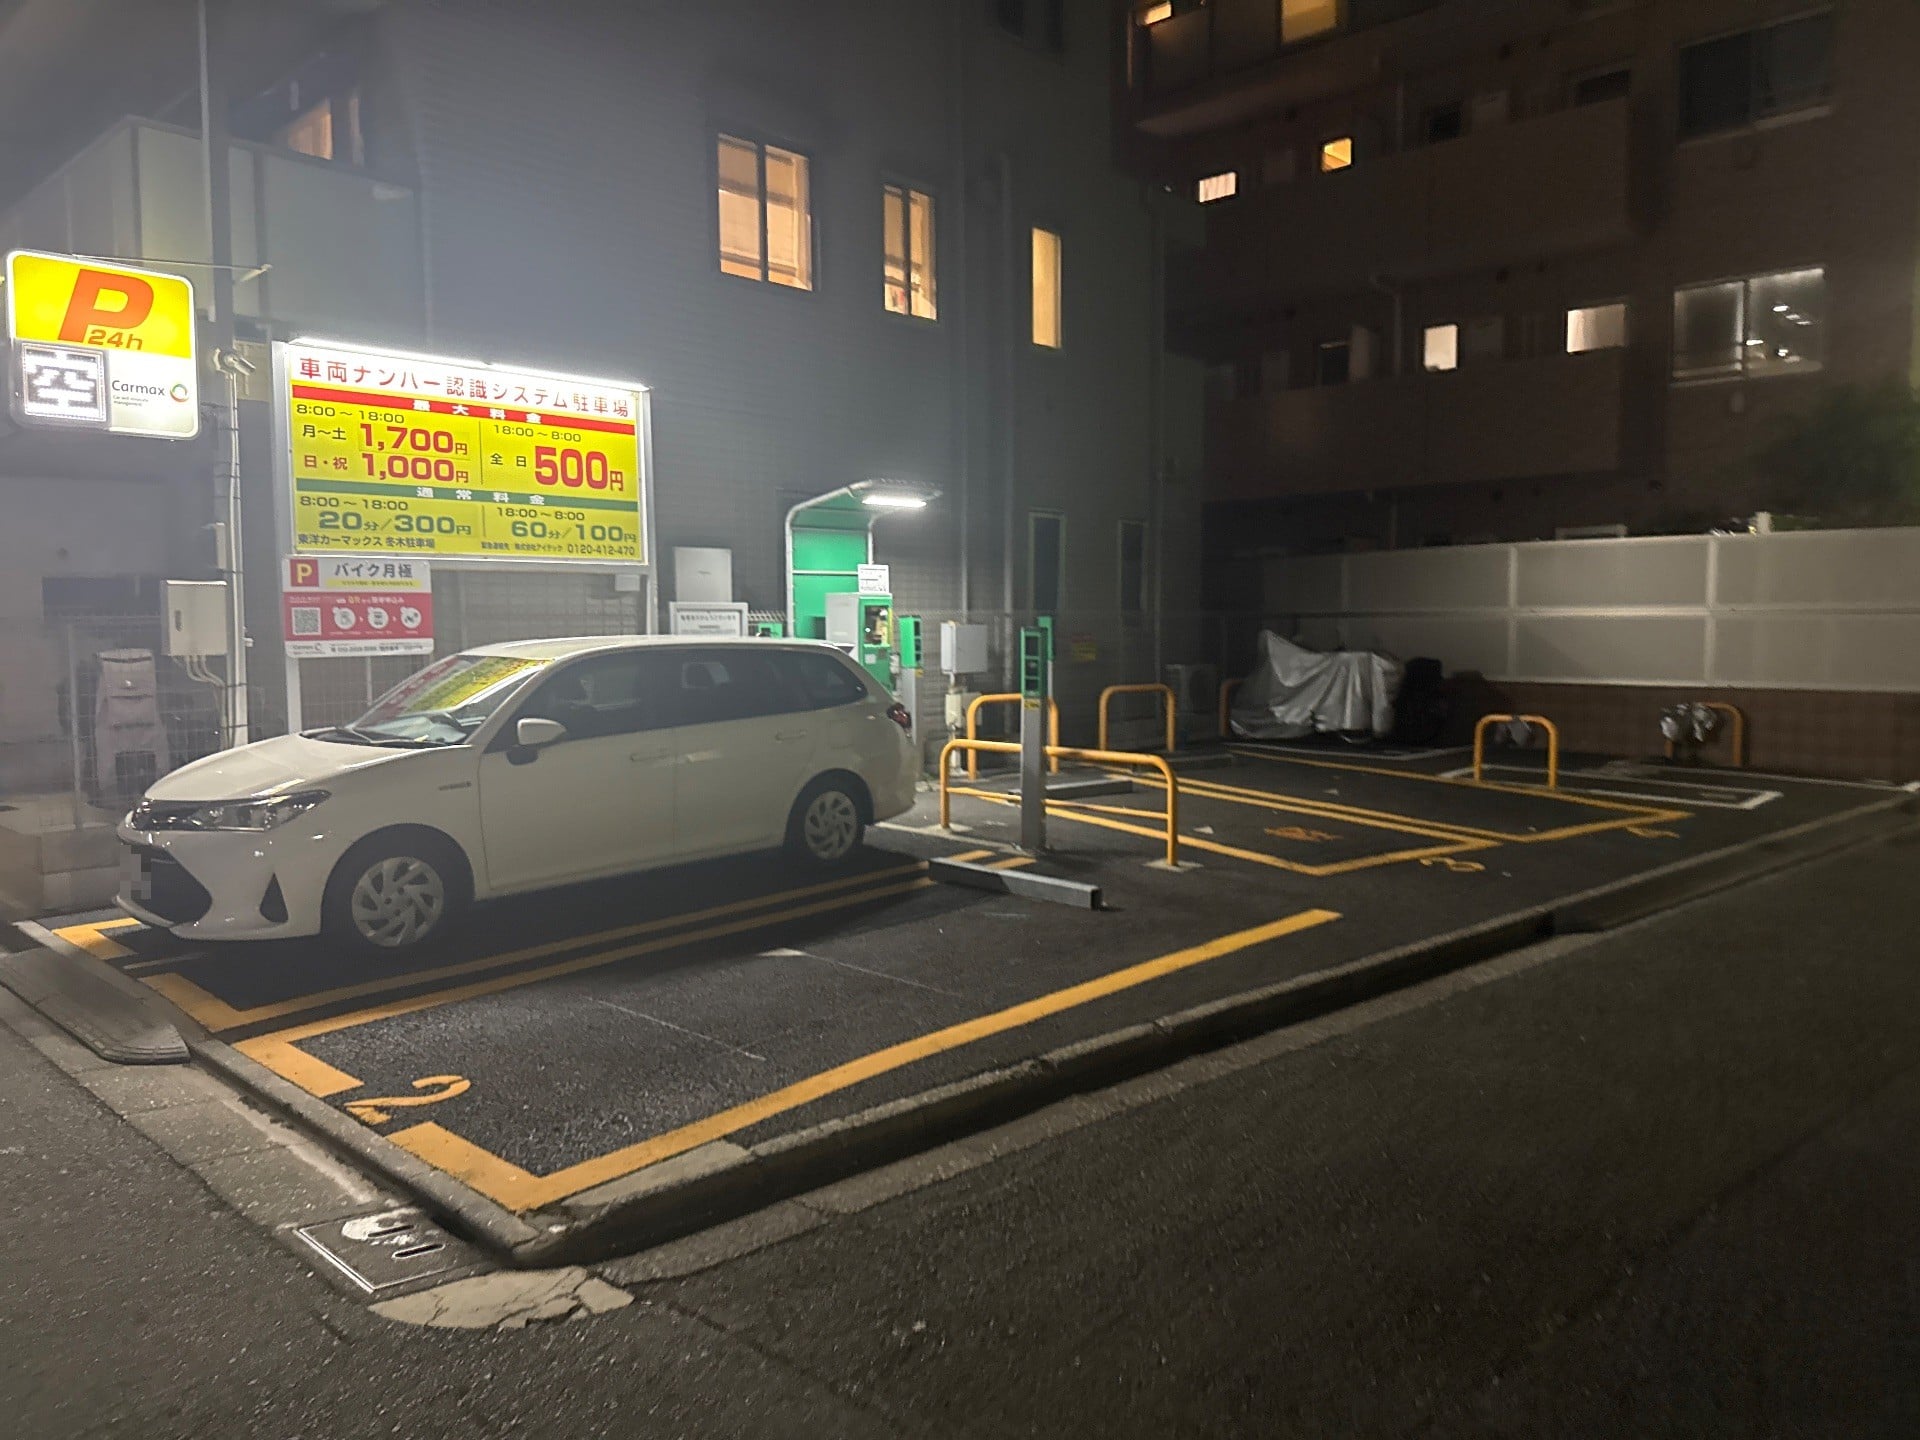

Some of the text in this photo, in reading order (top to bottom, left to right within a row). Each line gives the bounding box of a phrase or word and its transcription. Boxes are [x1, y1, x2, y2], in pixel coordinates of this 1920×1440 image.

[58, 269, 154, 343] P
[88, 329, 143, 350] 24h
[111, 380, 165, 396] Carmax
[360, 423, 468, 455] 1,700円
[362, 453, 469, 483] 1,000円
[534, 446, 624, 491] 500円
[296, 563, 313, 583] P
[335, 563, 413, 577] バイク月極
